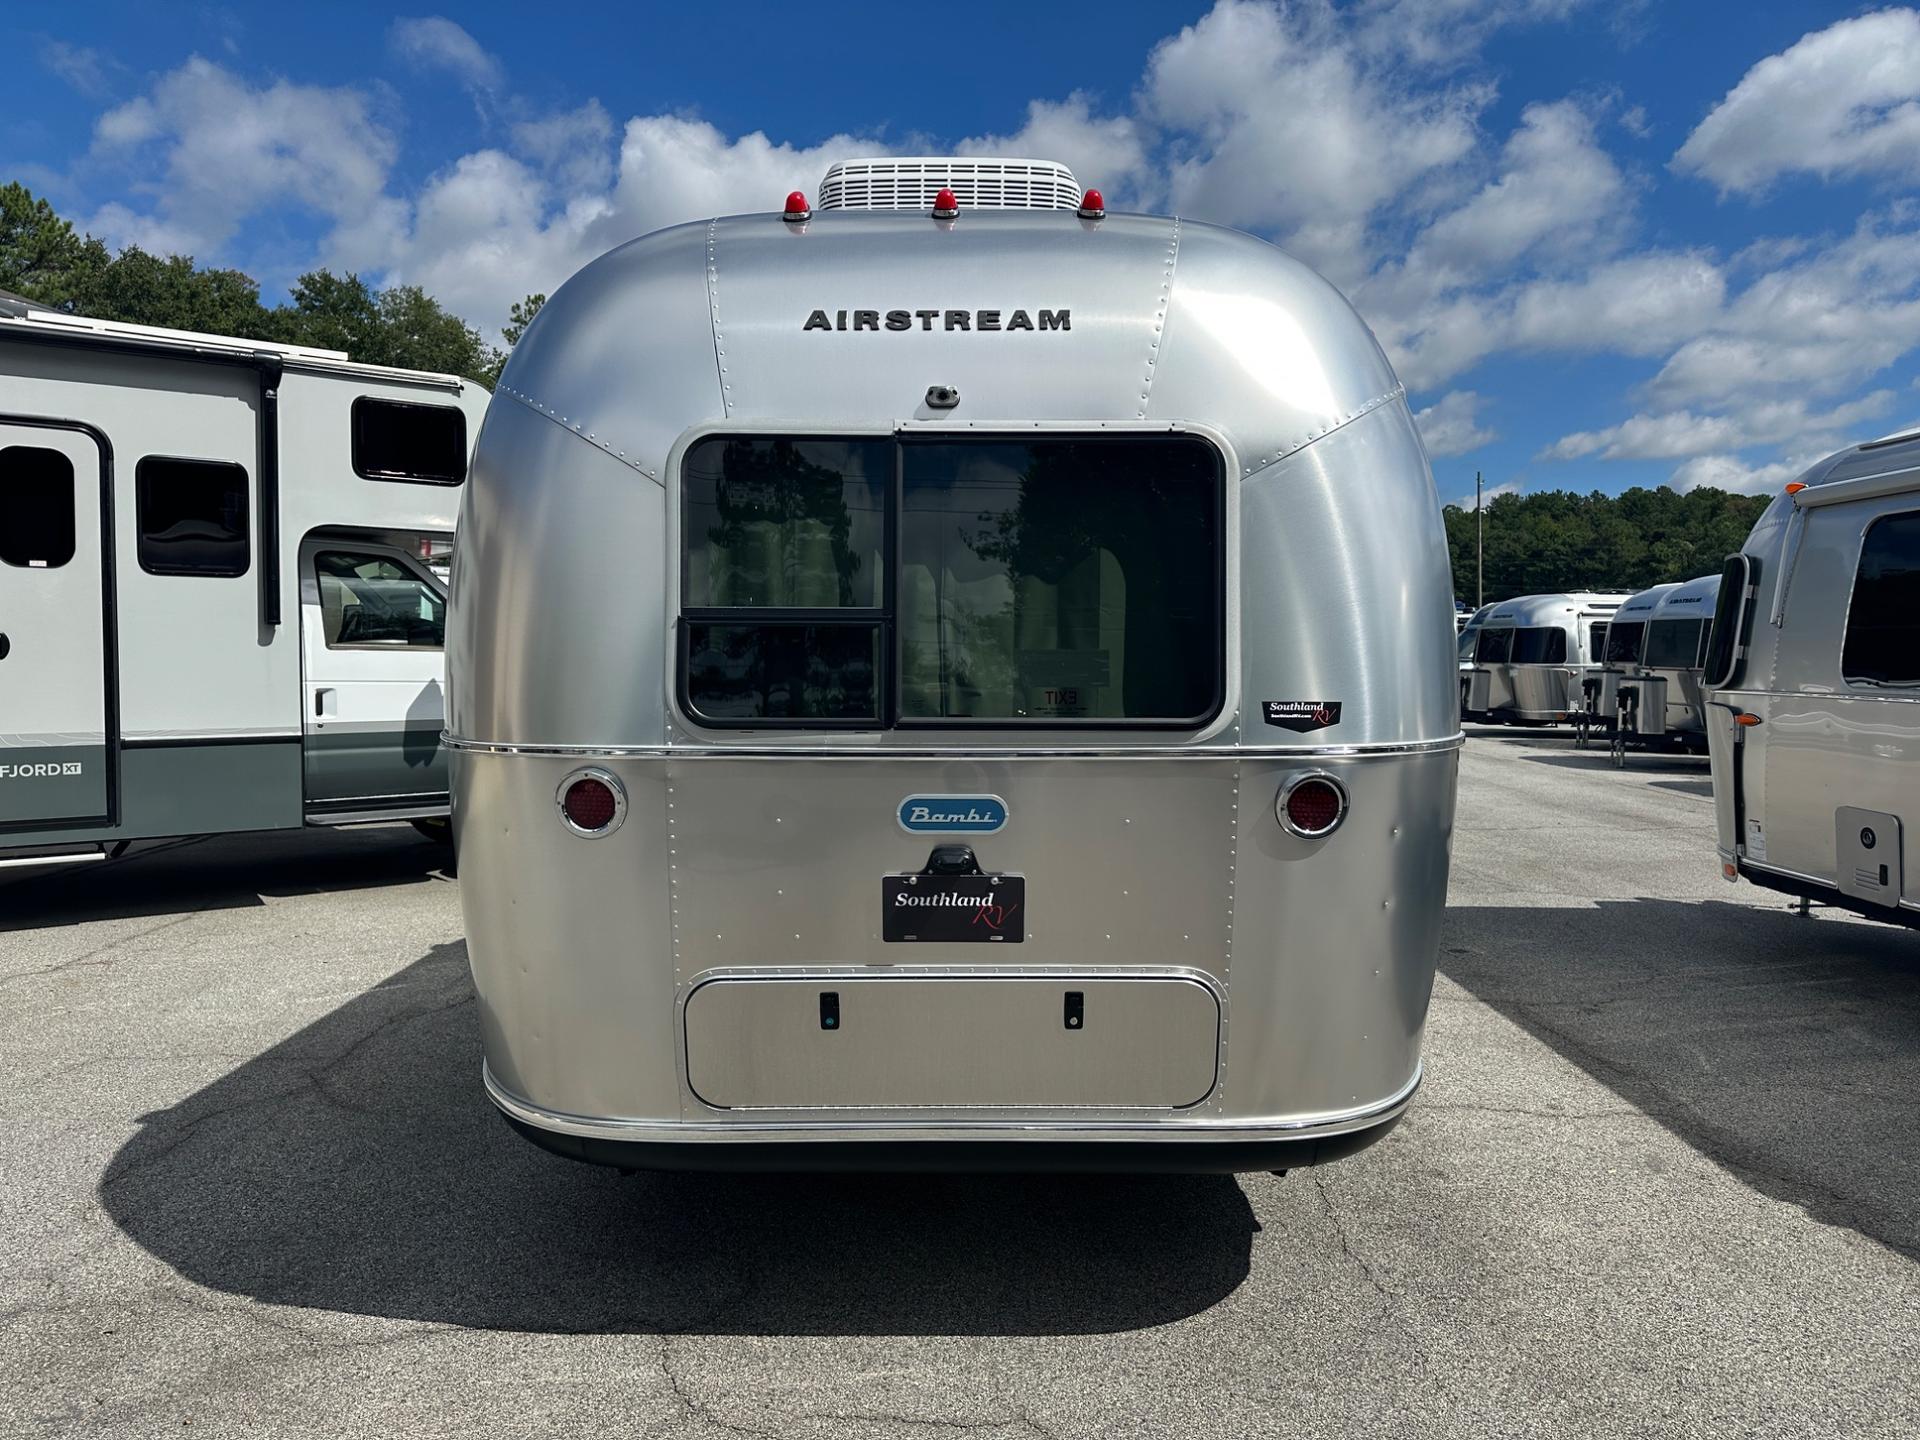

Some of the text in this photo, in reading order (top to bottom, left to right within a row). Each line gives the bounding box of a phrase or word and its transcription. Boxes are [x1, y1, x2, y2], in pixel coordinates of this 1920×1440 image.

[803, 310, 1071, 330] AIRSTREAM
[1269, 703, 1324, 711] Southland
[1312, 708, 1336, 725] RV
[0, 763, 80, 778] FJORD XT
[910, 806, 995, 823] Bambi
[895, 892, 994, 907] Southland
[973, 903, 1017, 930] RV
